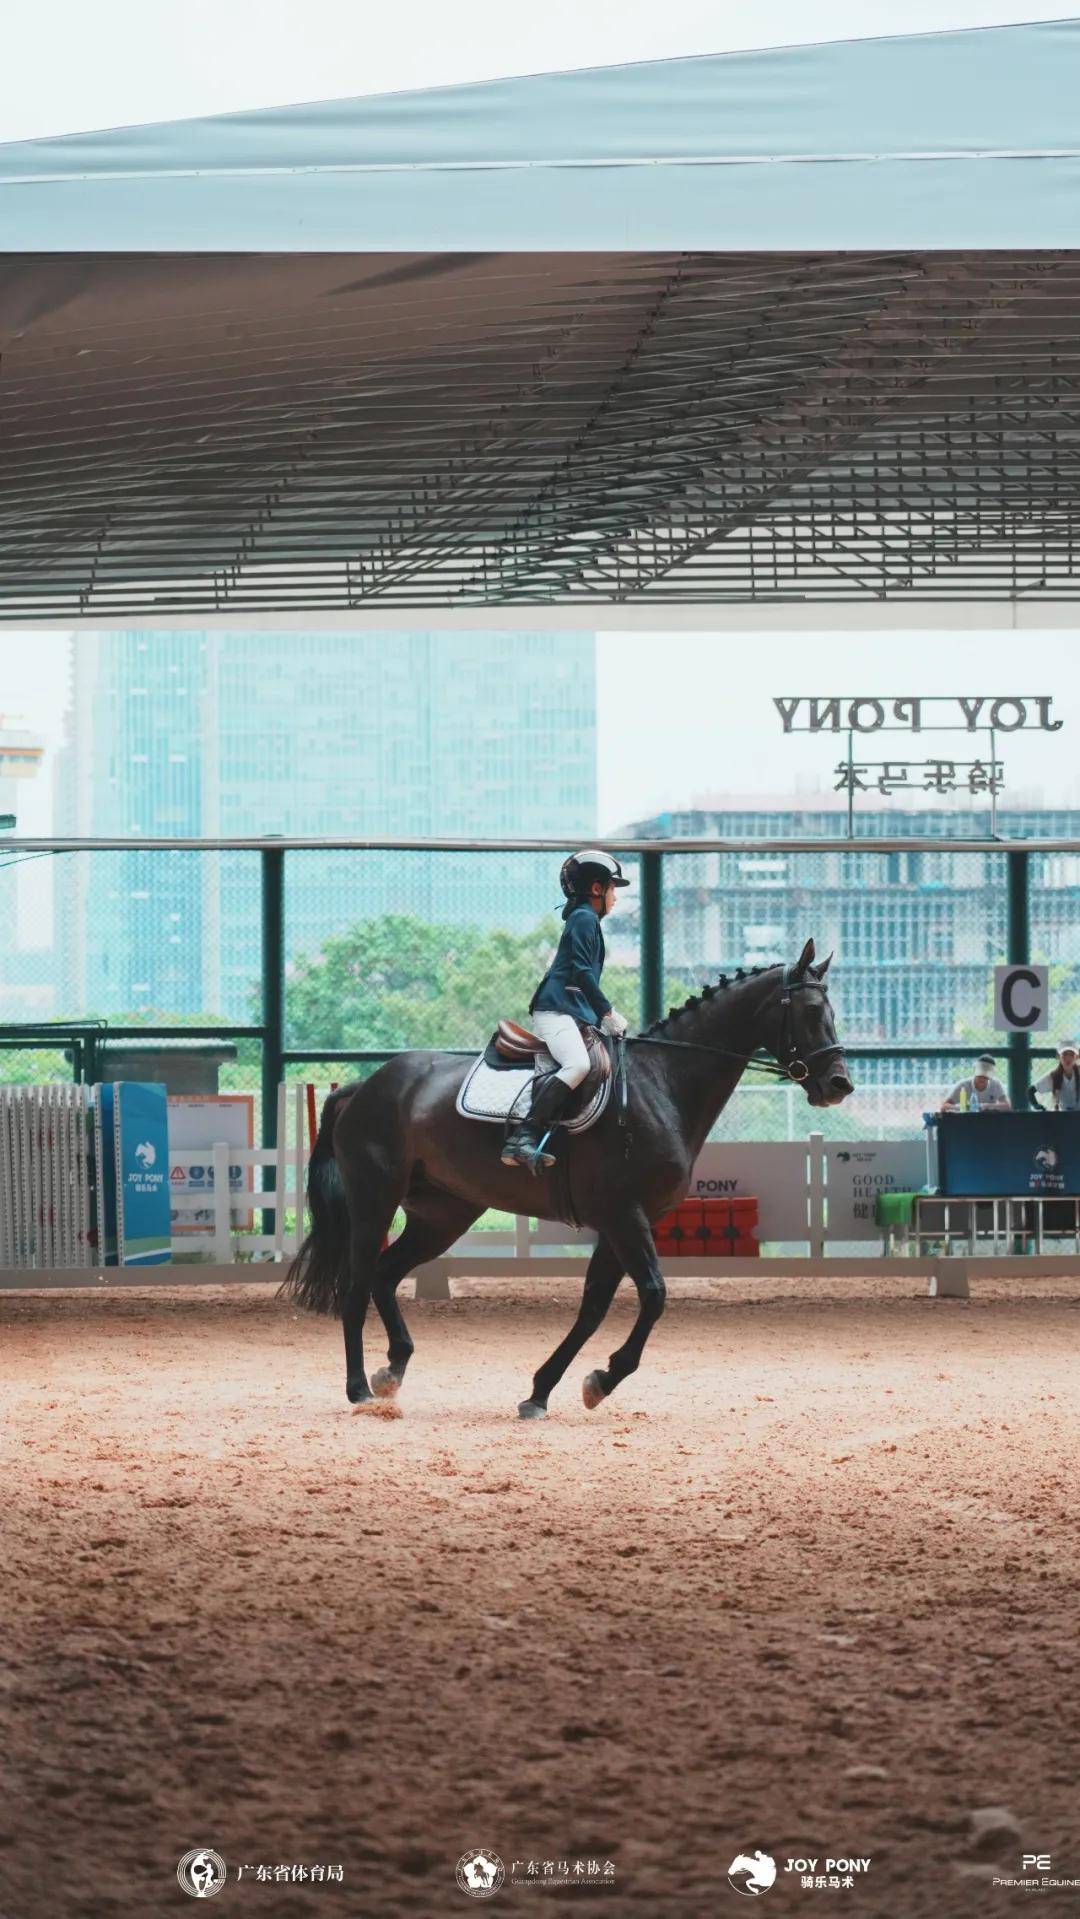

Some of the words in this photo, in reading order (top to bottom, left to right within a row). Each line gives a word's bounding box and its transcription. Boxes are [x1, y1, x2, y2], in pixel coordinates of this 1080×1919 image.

[1001, 969, 1042, 1027] C
[697, 1180, 738, 1192] PONY
[852, 1174, 894, 1186] GOOD
